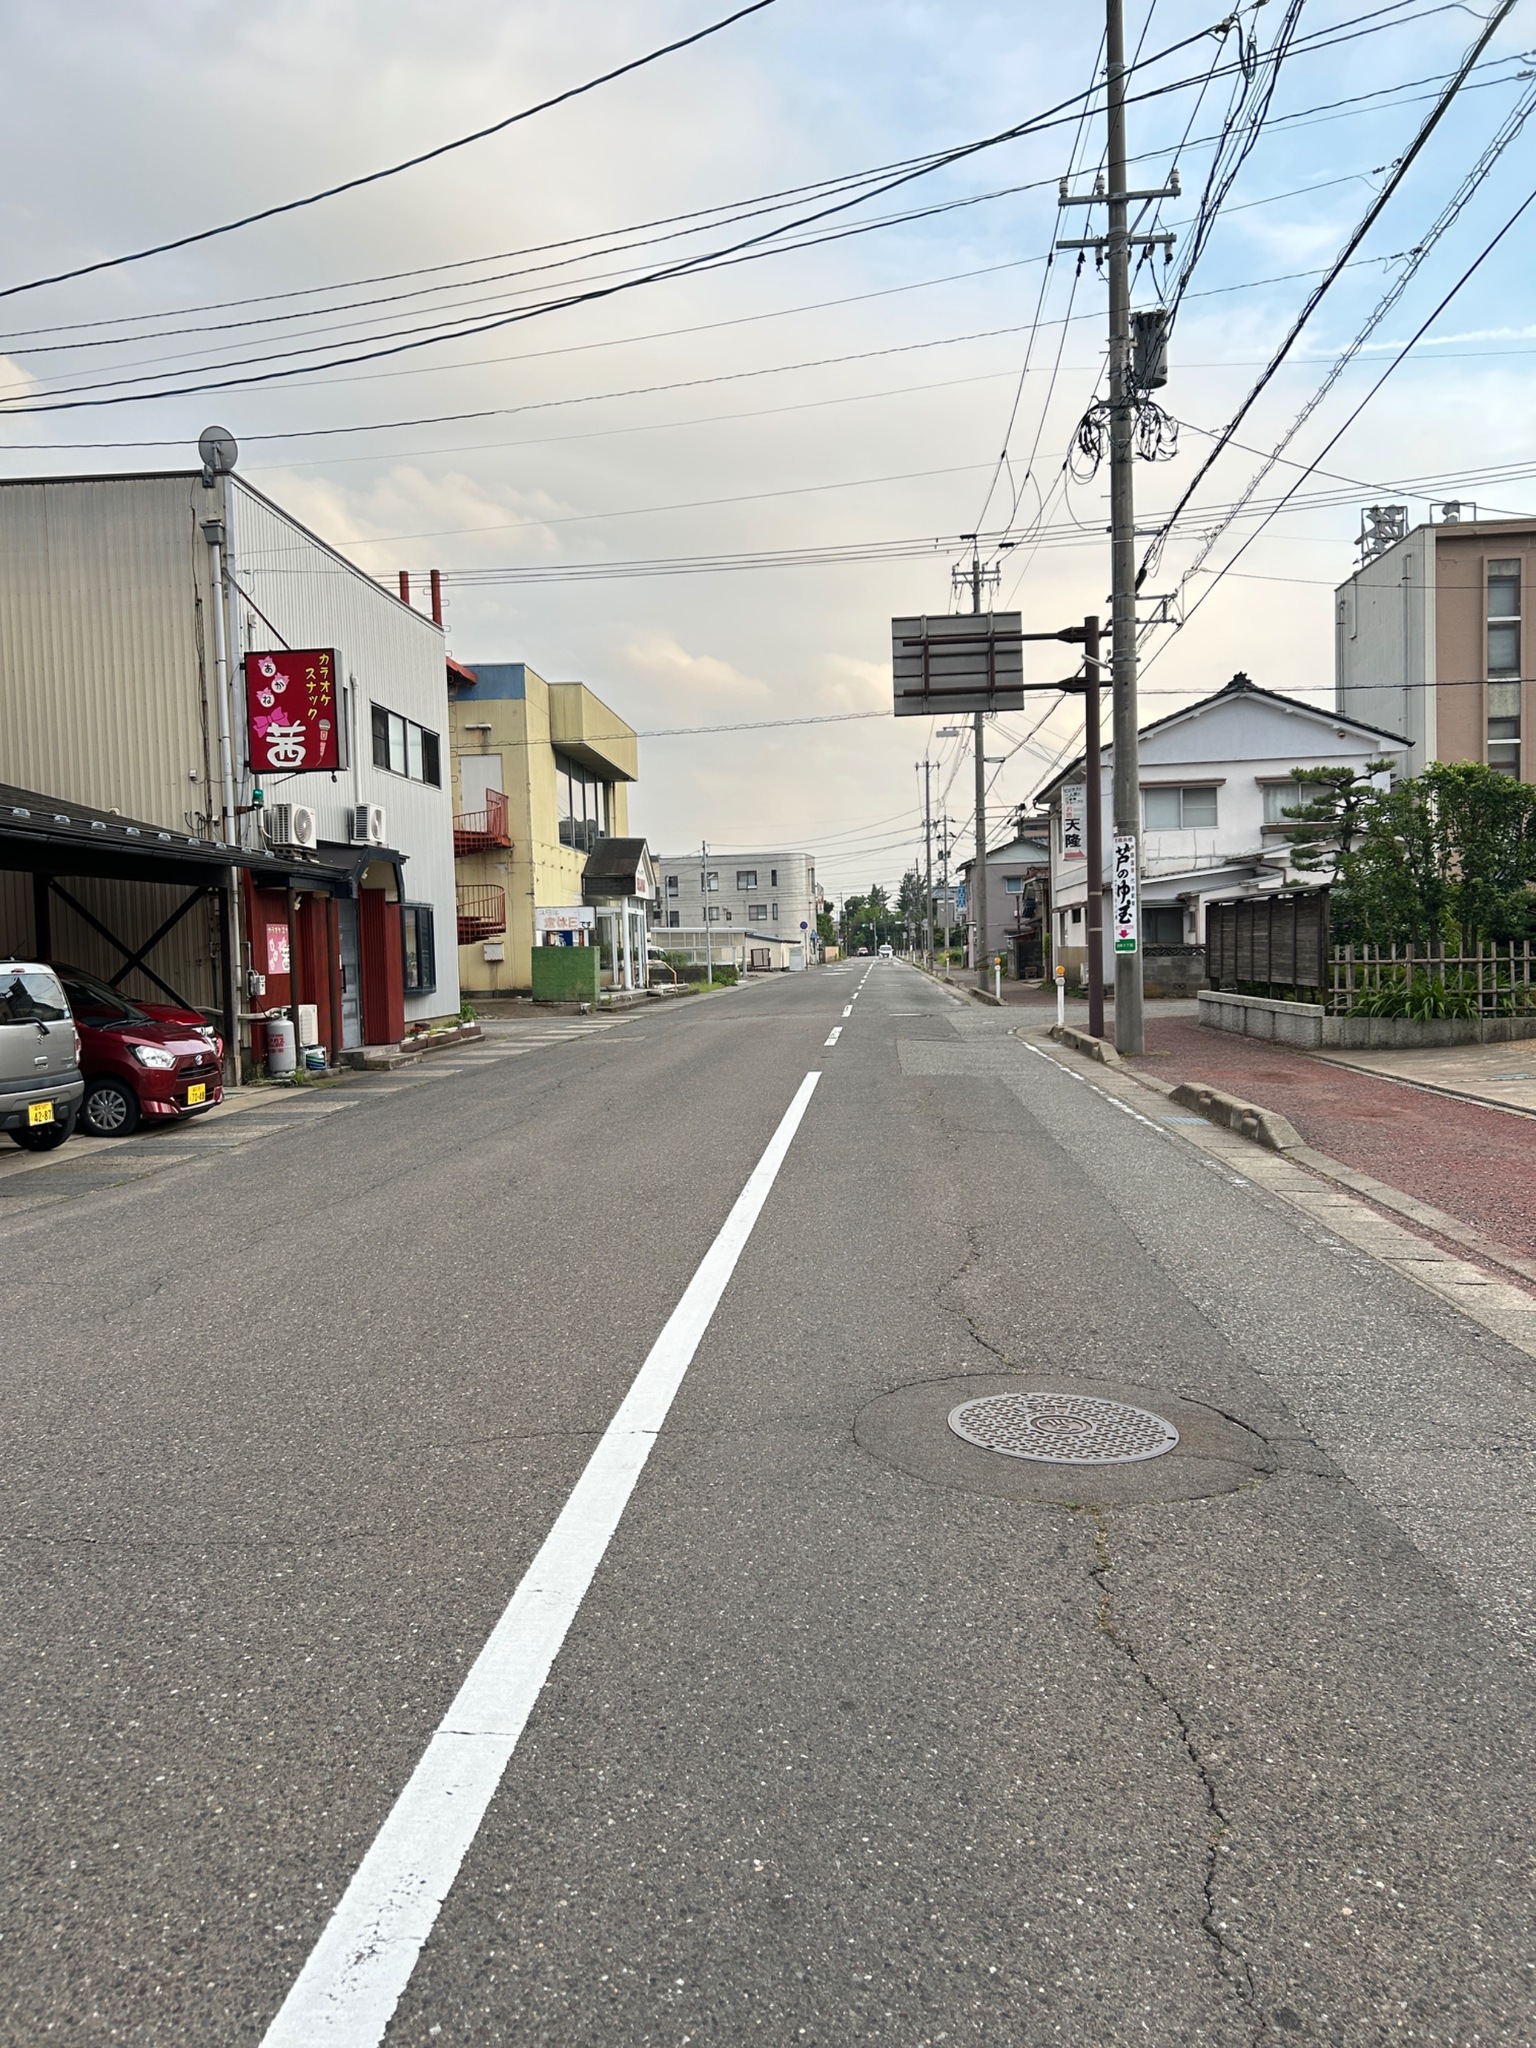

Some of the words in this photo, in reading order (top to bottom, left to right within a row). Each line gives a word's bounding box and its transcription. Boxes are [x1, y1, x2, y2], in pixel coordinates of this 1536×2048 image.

[262, 663, 285, 705] あかね
[306, 667, 318, 720] スナック
[319, 653, 331, 706] カラオケ
[266, 720, 306, 767] 茜
[1065, 818, 1081, 849] 天隆
[34, 1109, 52, 1122] 42-87
